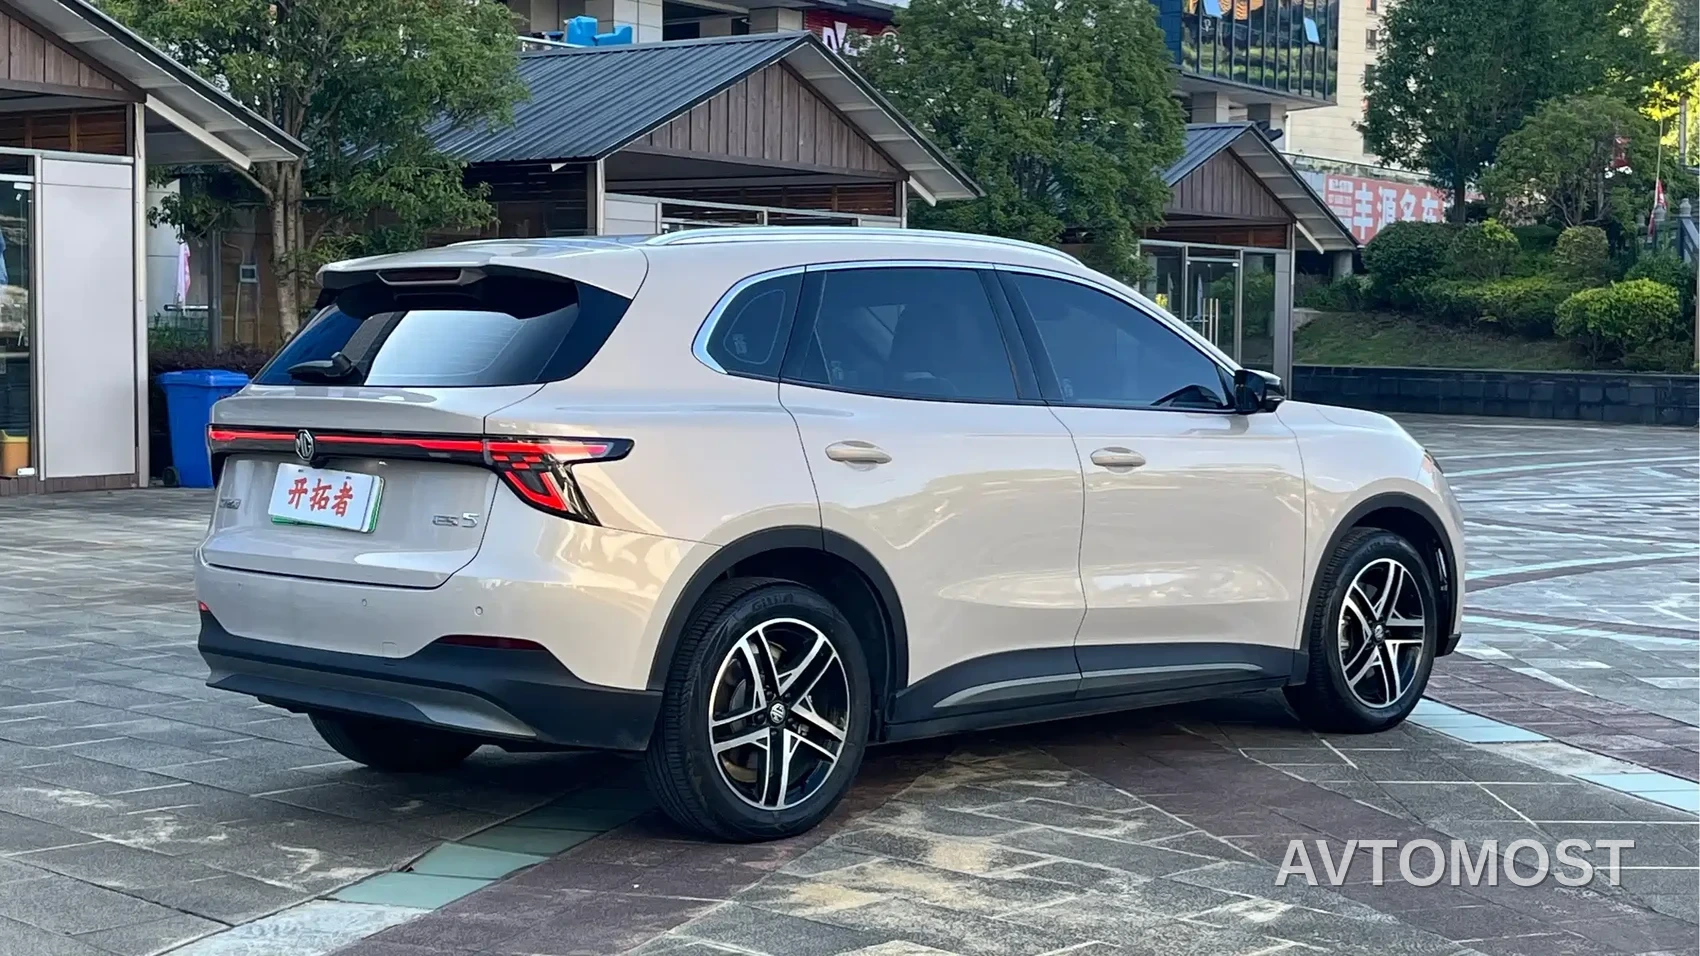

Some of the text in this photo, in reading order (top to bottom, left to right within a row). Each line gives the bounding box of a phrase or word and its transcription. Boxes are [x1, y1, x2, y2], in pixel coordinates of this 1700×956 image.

[295, 430, 314, 460] MG
[288, 477, 353, 517] 开拓者
